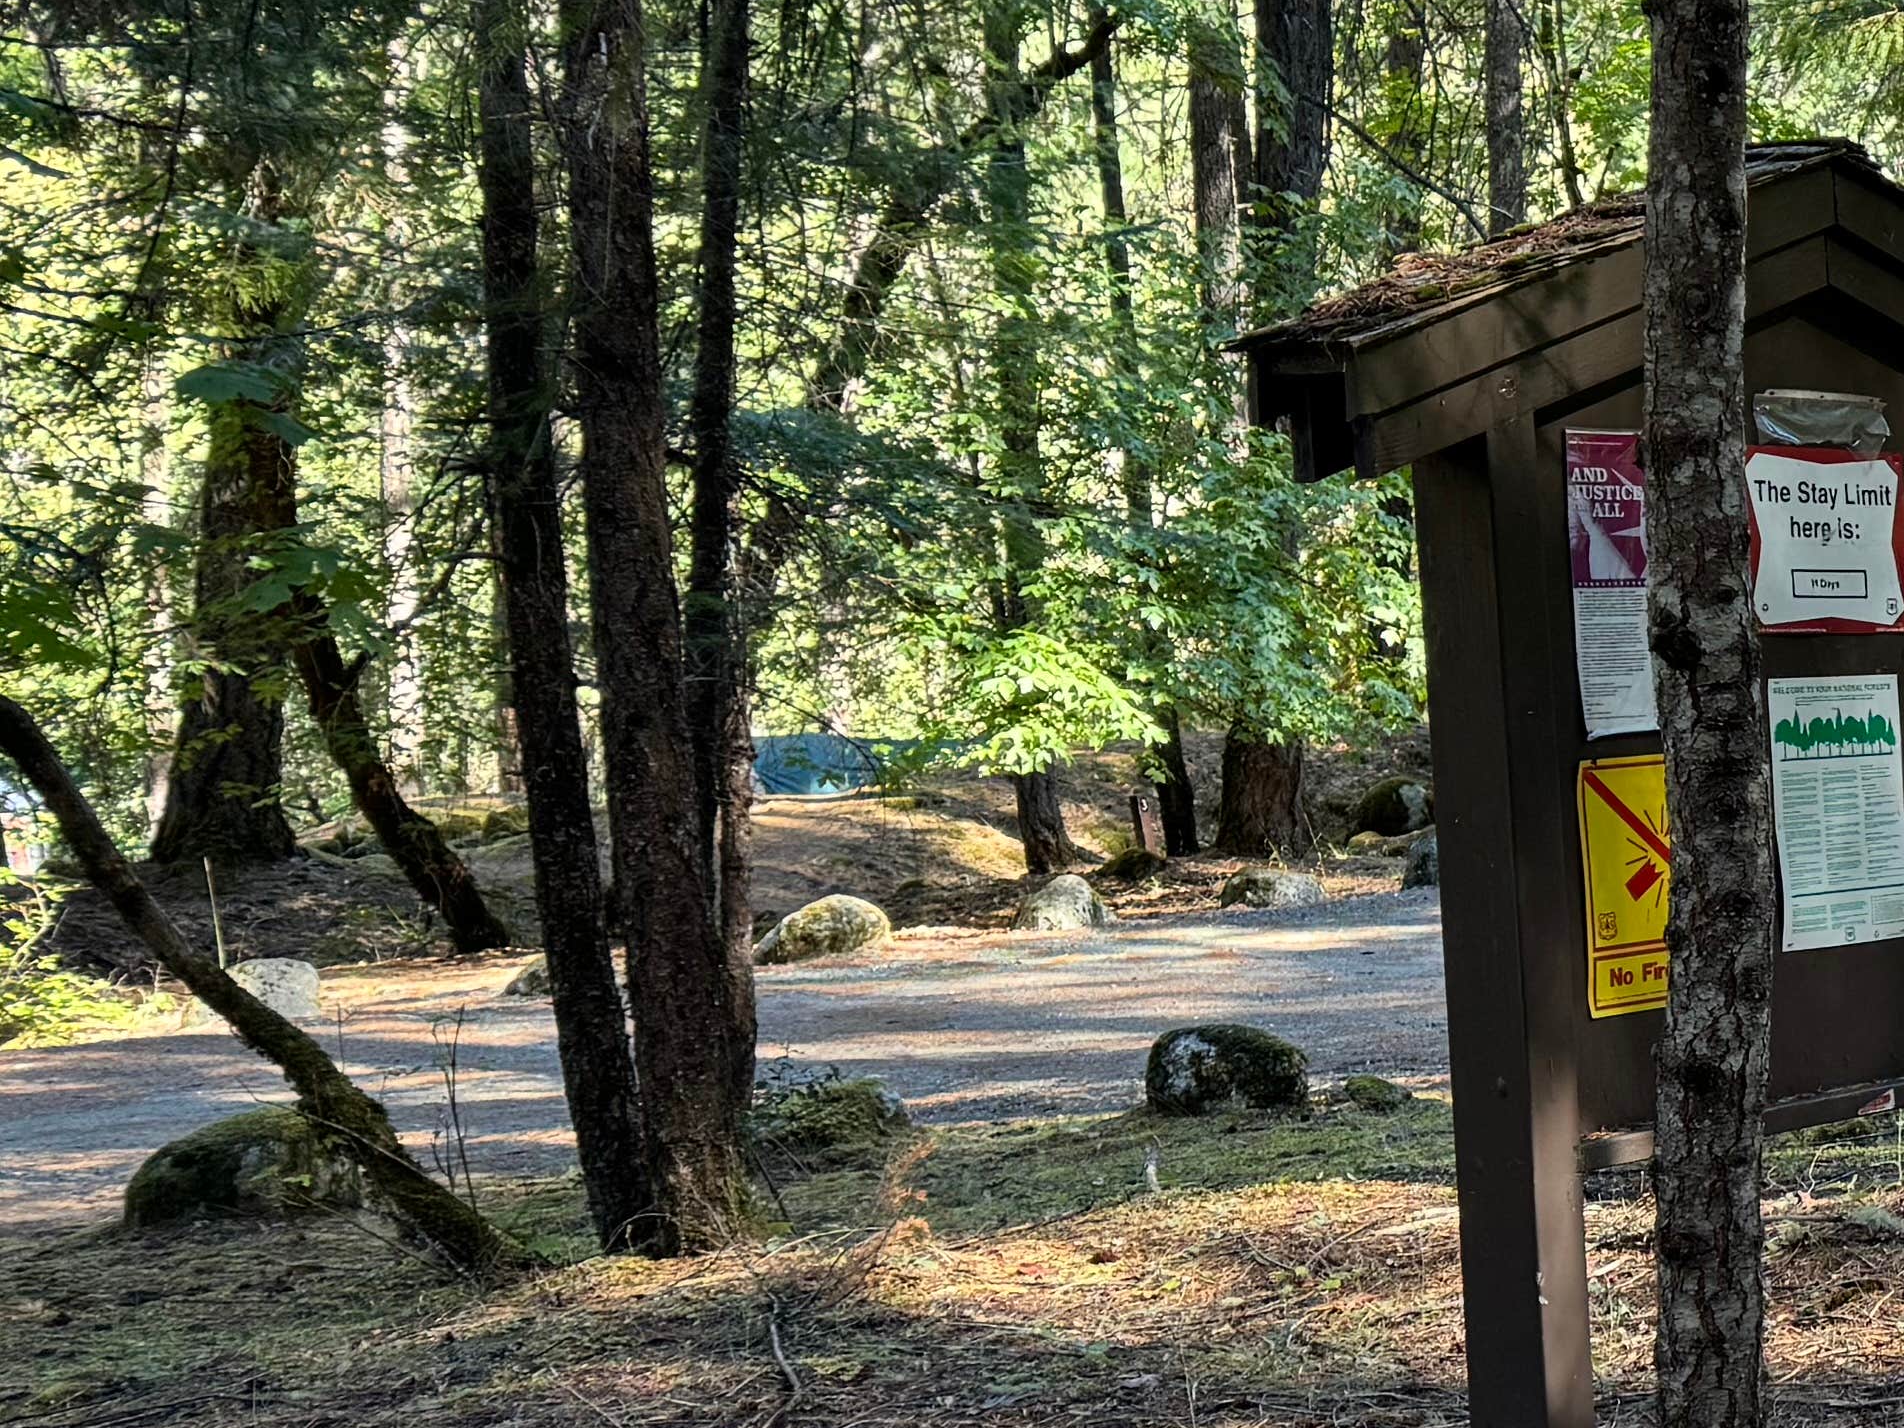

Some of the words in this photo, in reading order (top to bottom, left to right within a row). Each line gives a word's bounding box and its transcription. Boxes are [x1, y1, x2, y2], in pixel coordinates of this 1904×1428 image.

[1571, 467, 1608, 482] AND
[1572, 484, 1645, 501] JUSTICE
[1753, 479, 1791, 503] The
[1797, 480, 1838, 510] Stay
[1844, 483, 1892, 506] Limit
[1592, 502, 1625, 518] ALL
[1790, 516, 1831, 540] here
[1837, 517, 1861, 540] is:
[1609, 967, 1634, 988] No
